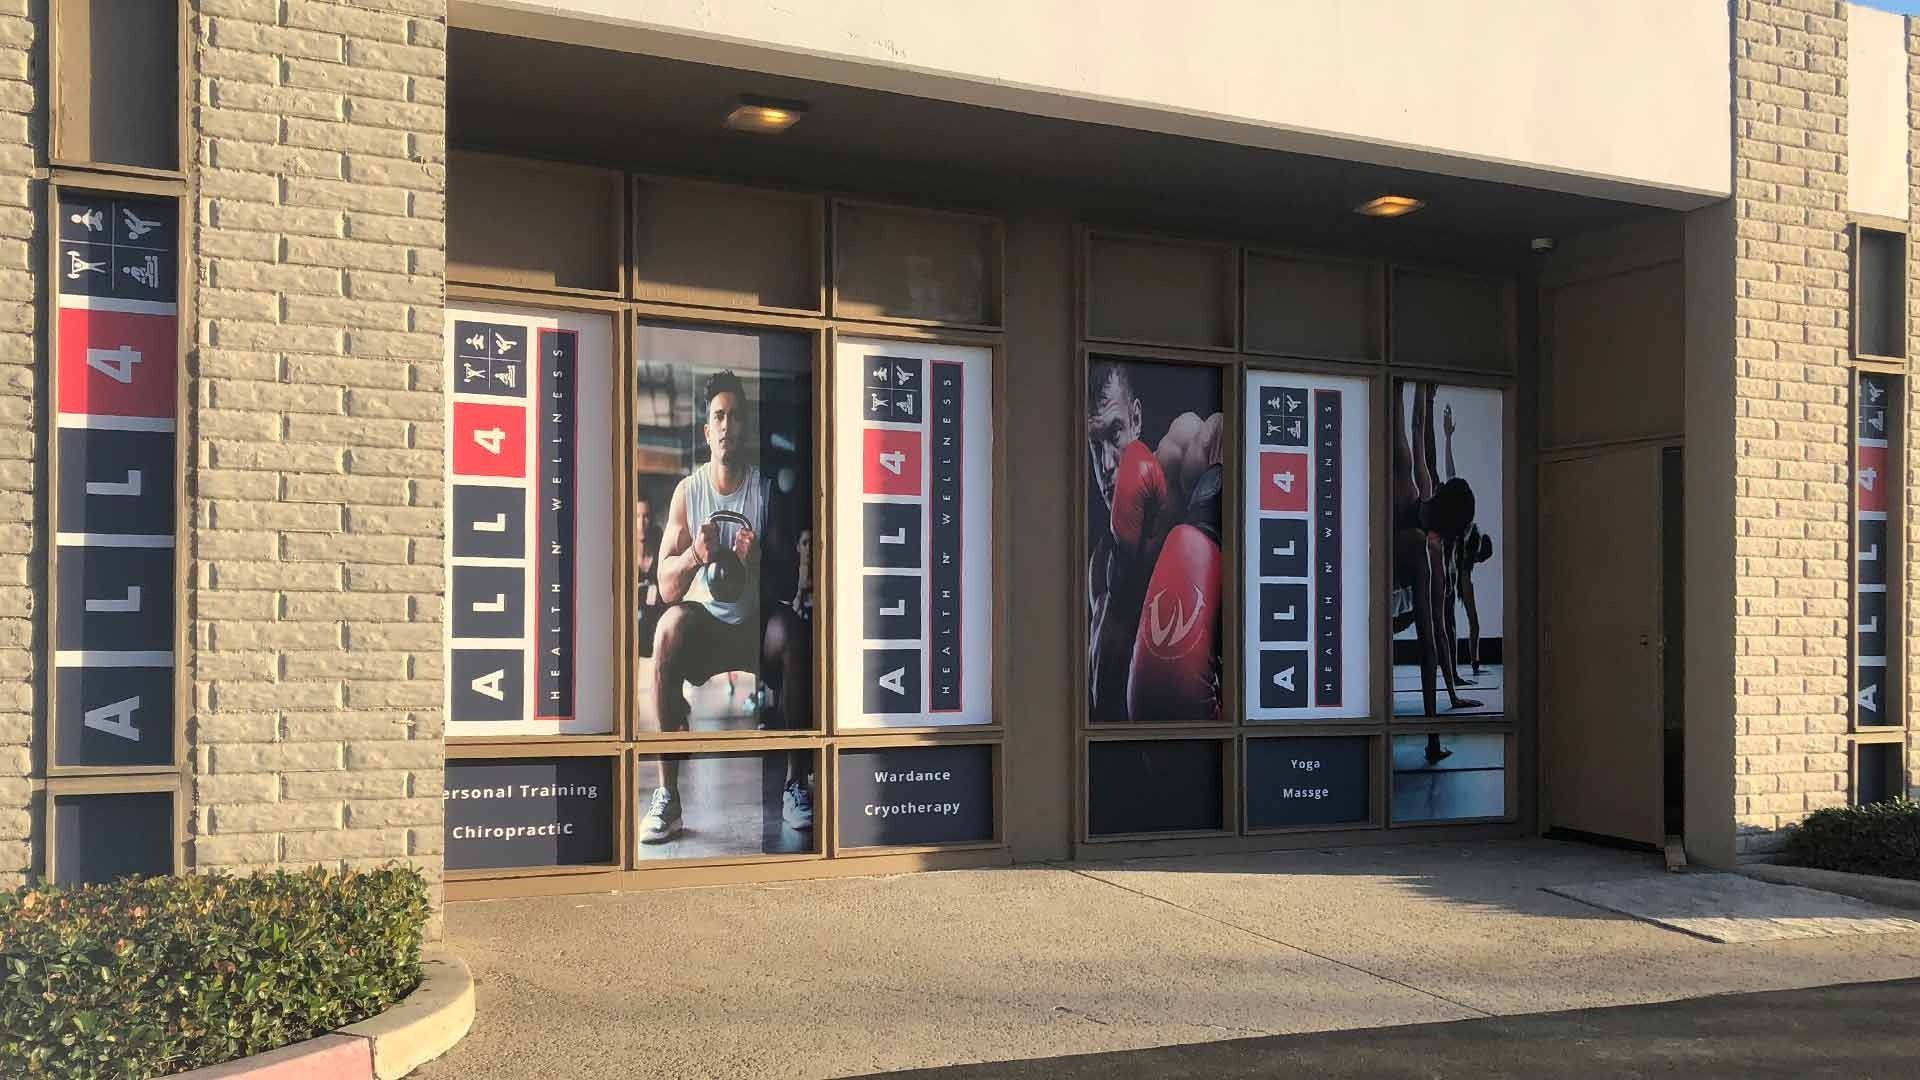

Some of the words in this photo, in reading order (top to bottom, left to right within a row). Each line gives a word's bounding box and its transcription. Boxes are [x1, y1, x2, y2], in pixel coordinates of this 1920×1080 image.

[87, 345, 143, 384] 4
[473, 427, 506, 455] 4
[552, 349, 564, 511] WELLNESS
[879, 450, 906, 475] 4
[941, 379, 952, 525] WELLNESS
[1272, 471, 1295, 493] 4
[1324, 406, 1333, 538] WELLNESS
[1858, 466, 1877, 491] 4
[85, 470, 142, 742] ALL
[471, 513, 506, 701] ALL
[879, 527, 906, 696] ALL
[1272, 540, 1295, 692] ALL
[550, 583, 561, 700] HEALTH
[942, 590, 951, 694] HEALTH
[1324, 596, 1333, 691] HEALTH
[874, 770, 951, 783] Wardance
[1290, 759, 1321, 772] Yoga
[443, 785, 513, 800] ersonal
[519, 783, 599, 799] Training
[864, 802, 961, 818] Cryotherapy
[1283, 788, 1329, 800] Massge
[452, 823, 573, 841] Chiropractic
